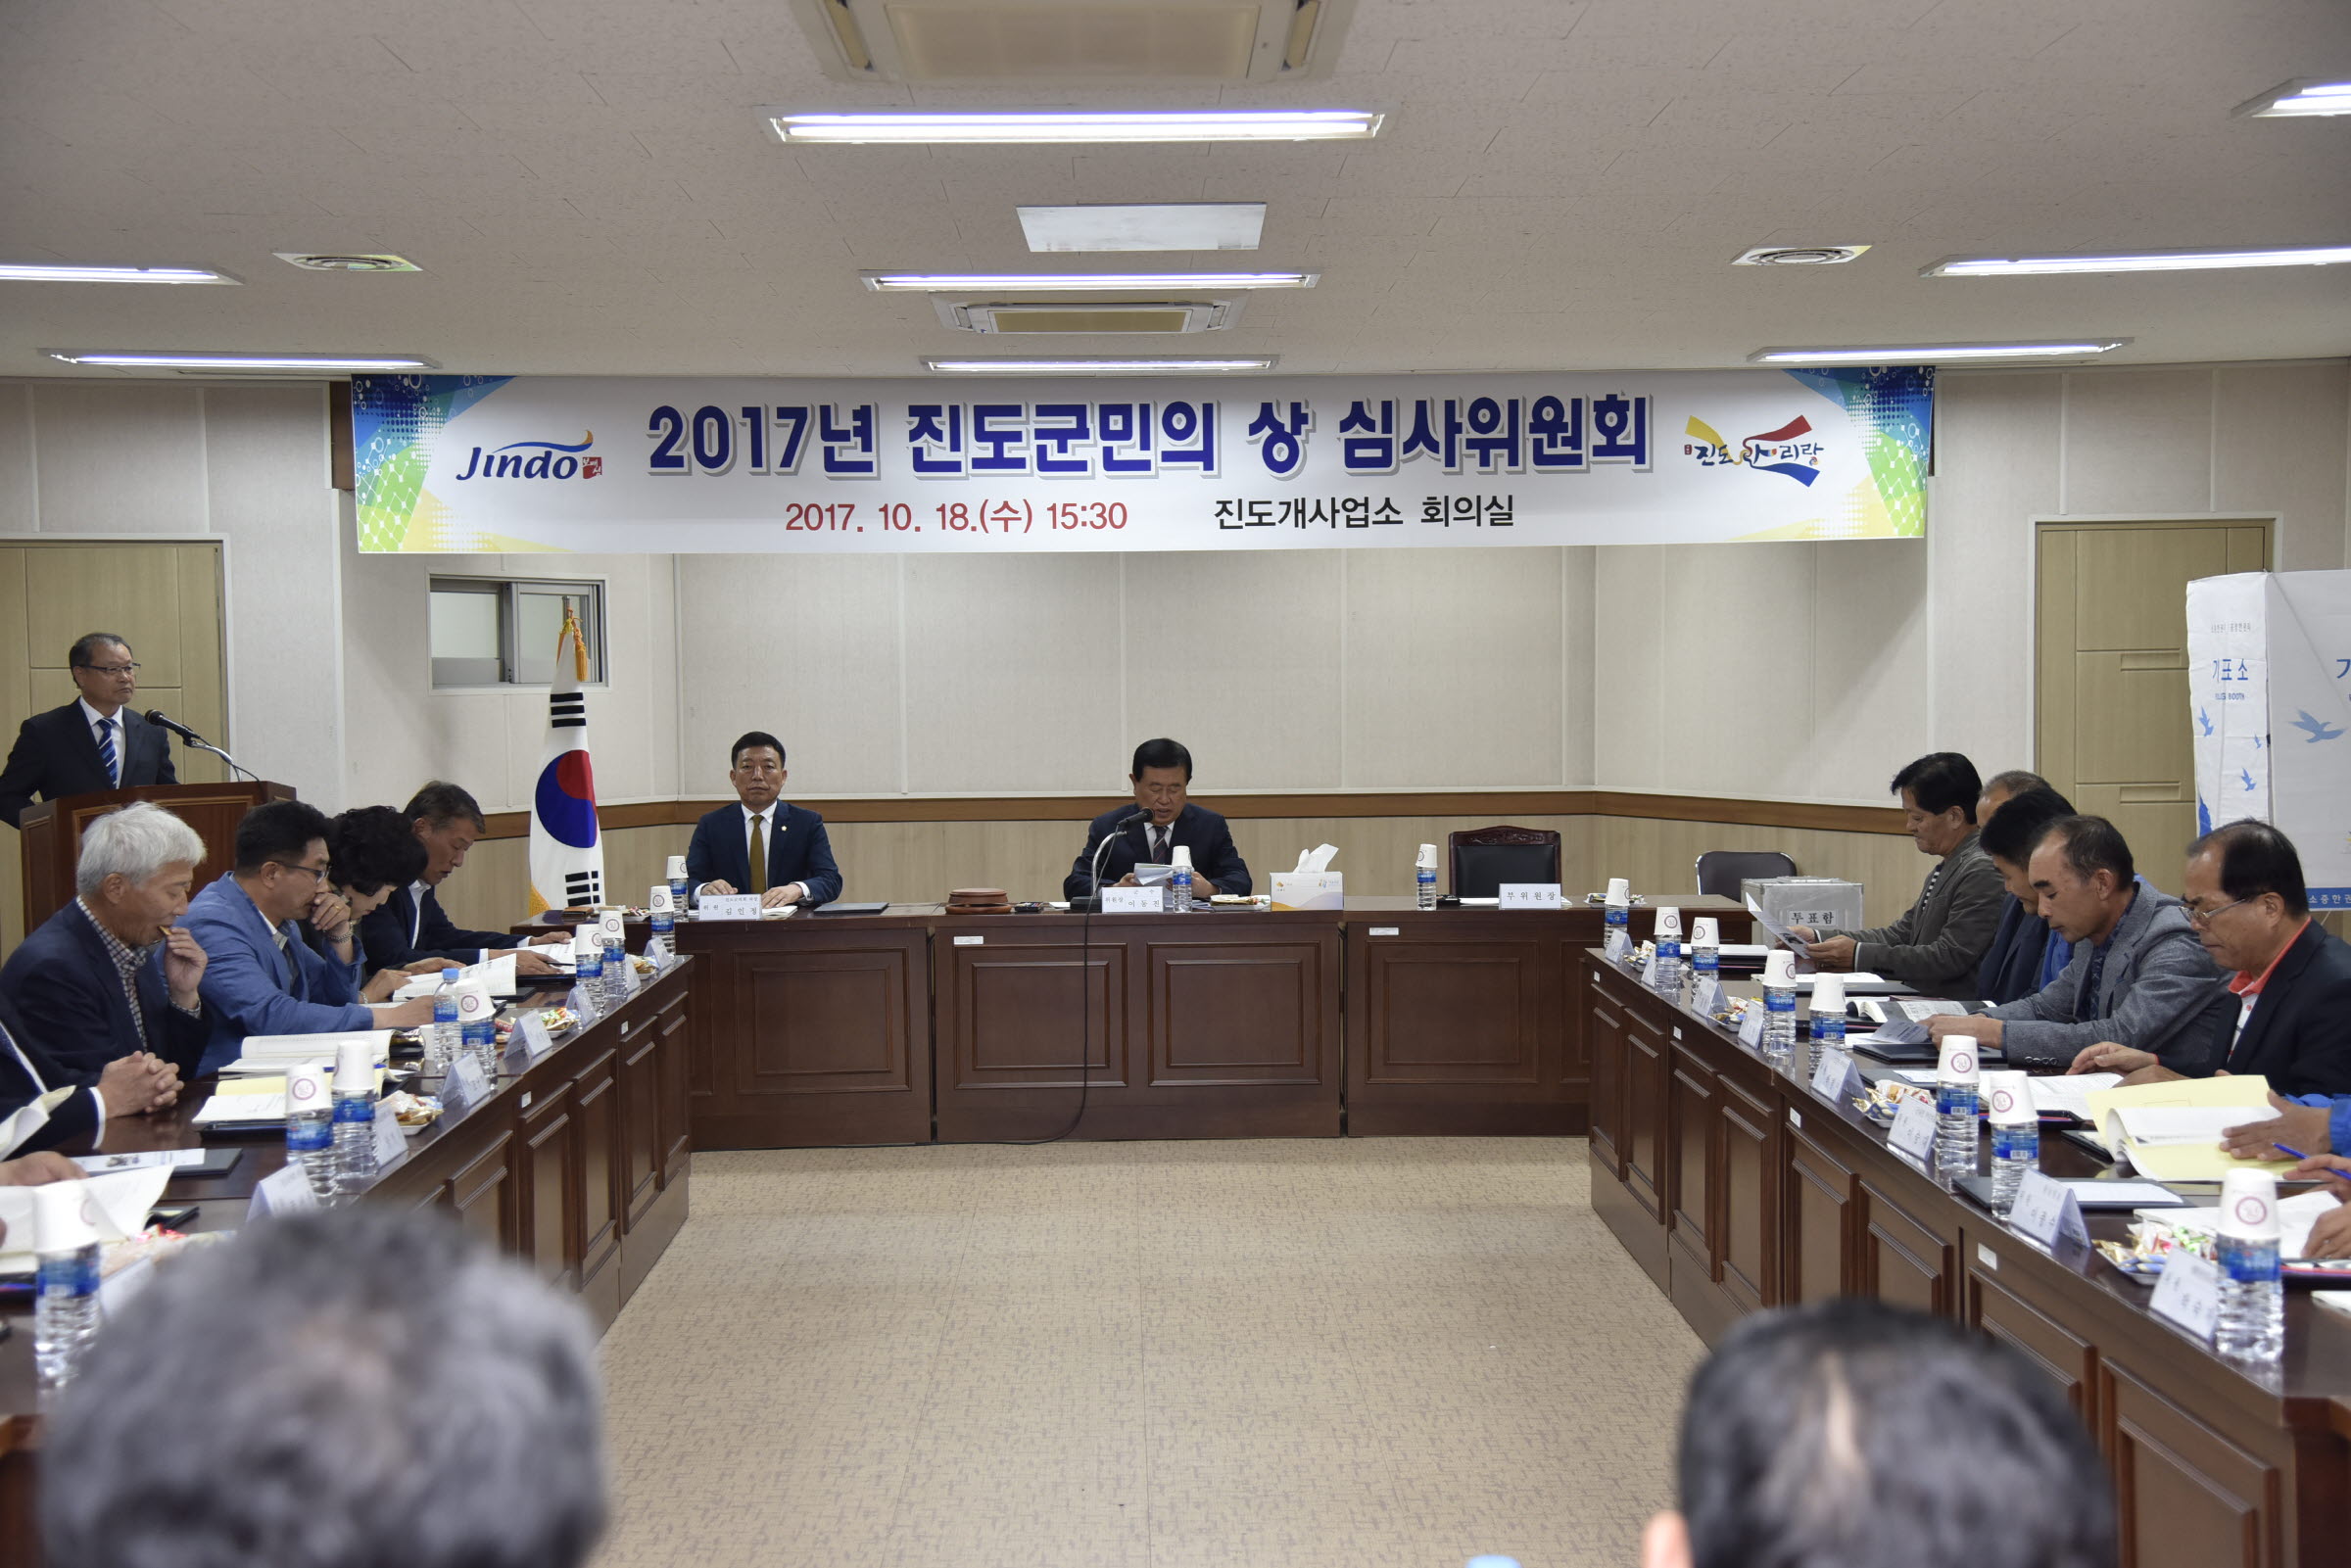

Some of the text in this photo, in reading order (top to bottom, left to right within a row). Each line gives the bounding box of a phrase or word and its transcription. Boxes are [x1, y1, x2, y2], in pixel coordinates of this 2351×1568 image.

[648, 394, 1648, 475] 2017년 진도군민의 상 심사위원회
[456, 447, 578, 480] Jindo
[786, 502, 864, 533] 2017.
[878, 502, 922, 532] 10.
[1045, 500, 1128, 531] 15:30
[1214, 493, 1515, 531] 진도개사업소 회의실
[1791, 911, 1835, 926] 투표함
